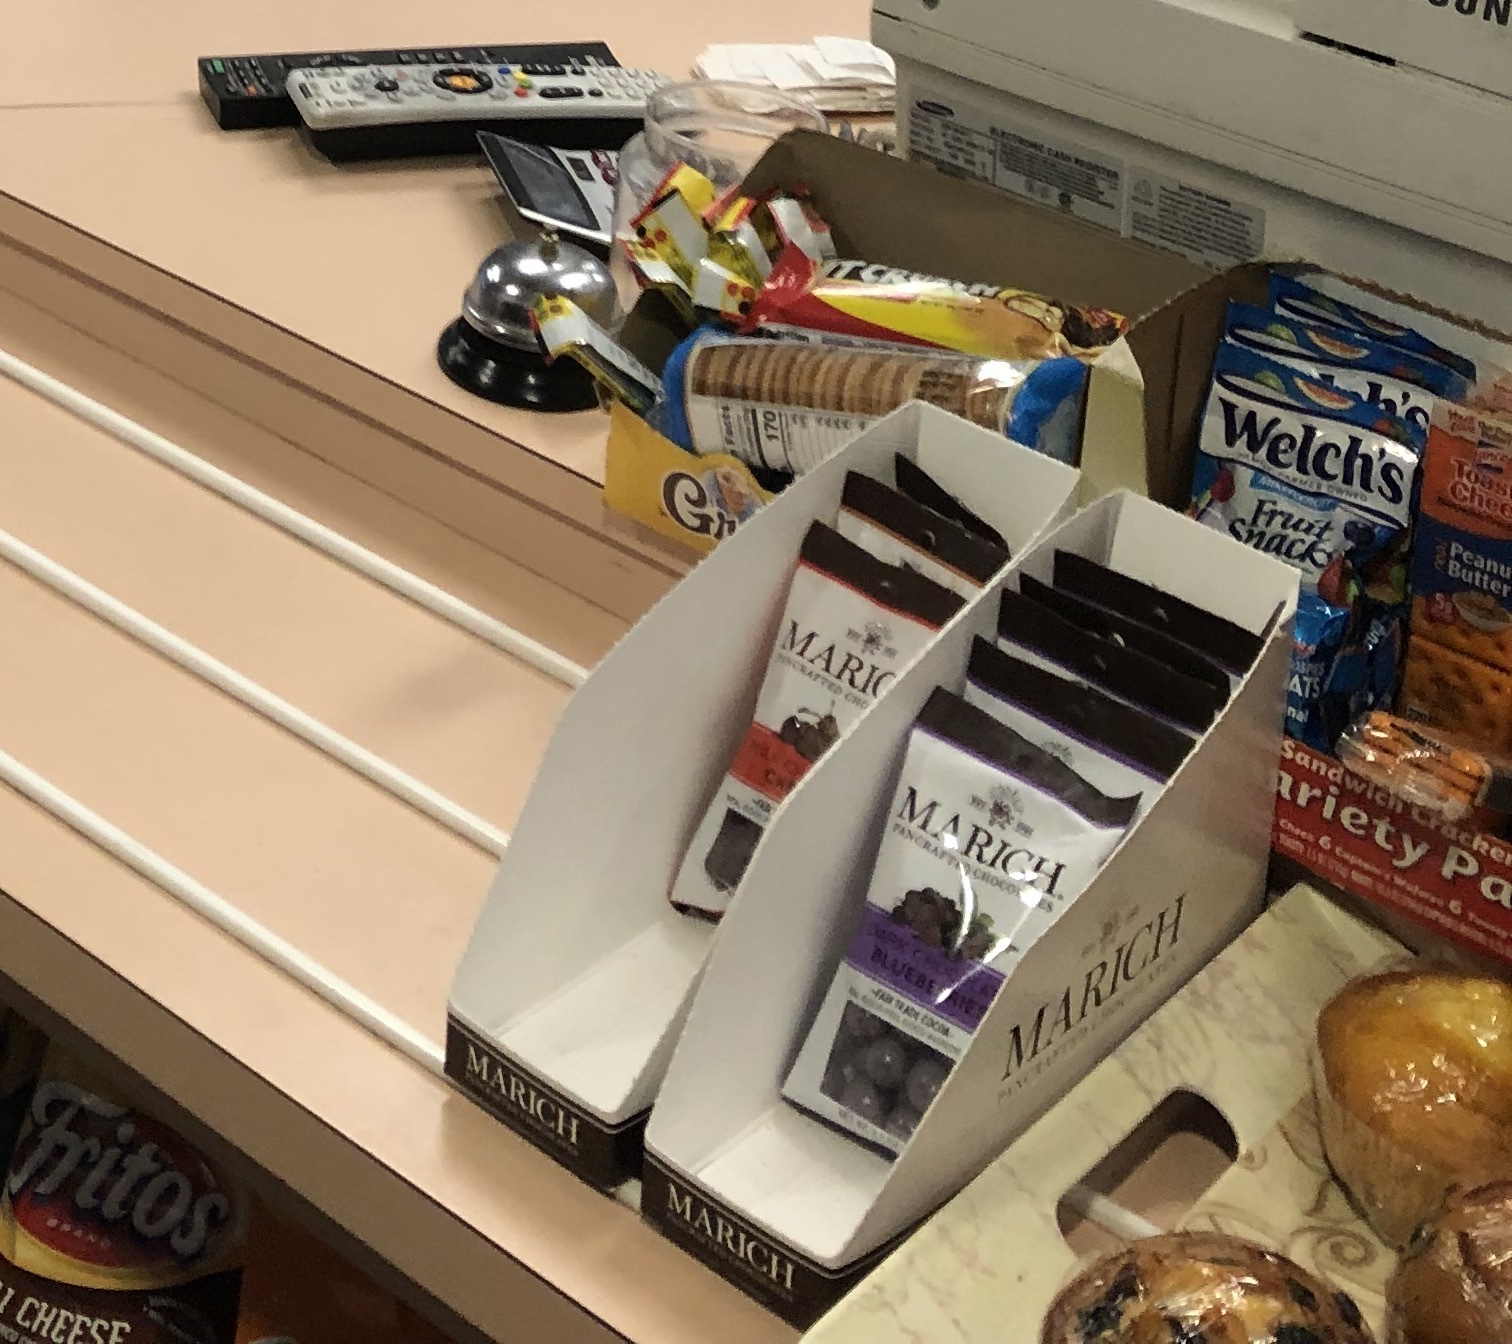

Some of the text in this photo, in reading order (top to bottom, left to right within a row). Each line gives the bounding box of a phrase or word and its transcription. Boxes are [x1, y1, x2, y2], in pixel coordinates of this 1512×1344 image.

[763, 410, 780, 441] 170
[1218, 397, 1404, 505] Welch's
[663, 473, 738, 540] Gr
[1251, 499, 1334, 539] Fruit
[1448, 559, 1512, 598] Butter
[1450, 542, 1512, 580] Peanu
[781, 619, 897, 699] MARIC
[1289, 673, 1321, 699] ATS
[897, 785, 1067, 896] MARICH
[1276, 770, 1512, 909] ariety Pa
[1281, 739, 1512, 867] Sandwich Cracker
[973, 868, 1054, 913] CHOCOES
[1001, 894, 1187, 1082] MARICH
[466, 1043, 581, 1146] MARICH
[8, 1080, 231, 1256] Fritos
[667, 1182, 795, 1290] MARICH
[16, 1296, 133, 1344] CHEESE
